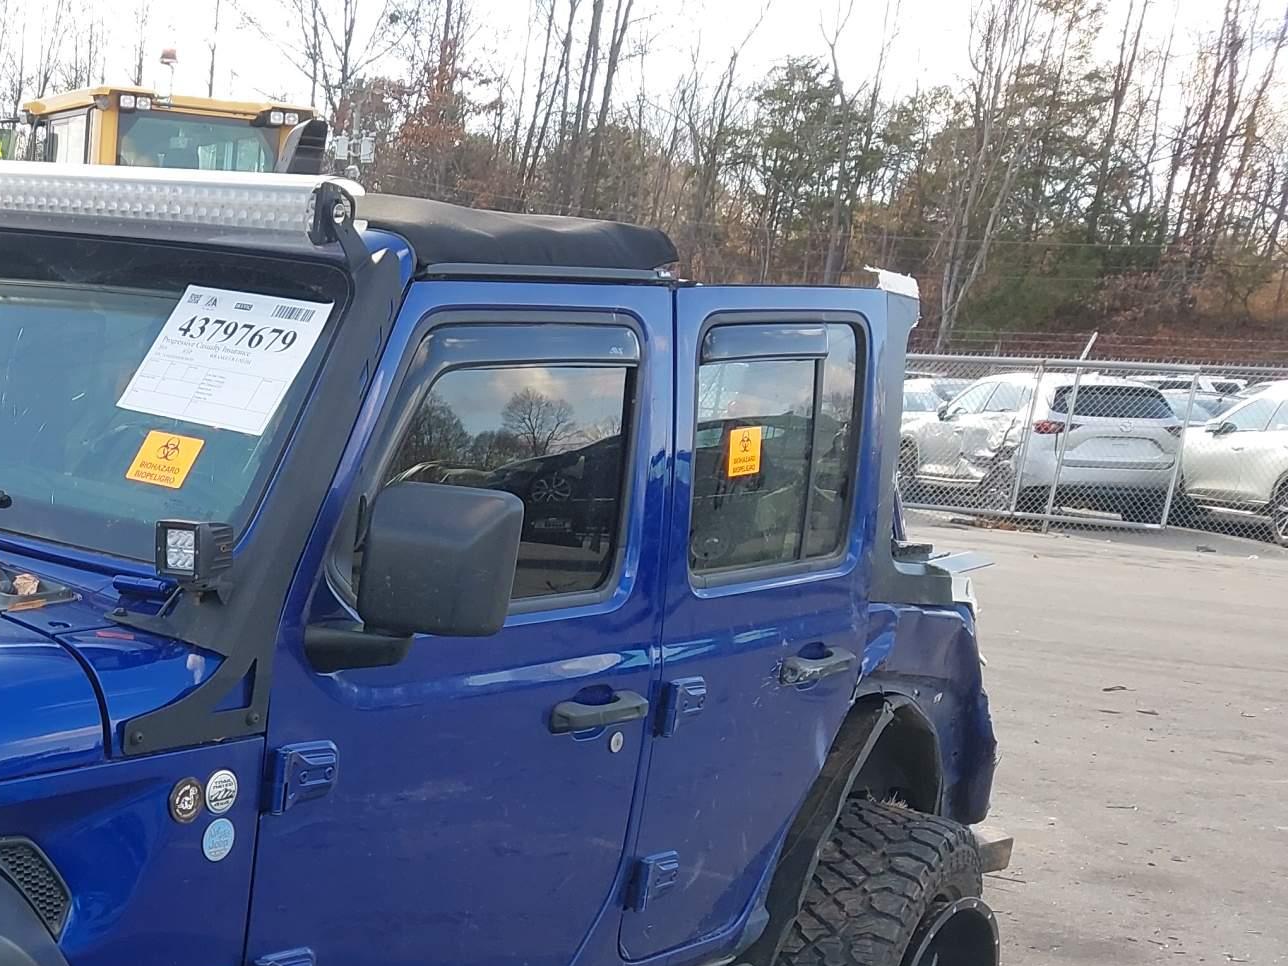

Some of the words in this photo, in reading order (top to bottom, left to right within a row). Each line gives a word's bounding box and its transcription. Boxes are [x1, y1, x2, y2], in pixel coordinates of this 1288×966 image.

[178, 315, 298, 353] 43797679
[162, 336, 196, 349] Progressive
[222, 345, 251, 357] Insurance
[139, 460, 180, 475] BIOHAZARD
[134, 470, 176, 484] BIOPELIGRO
